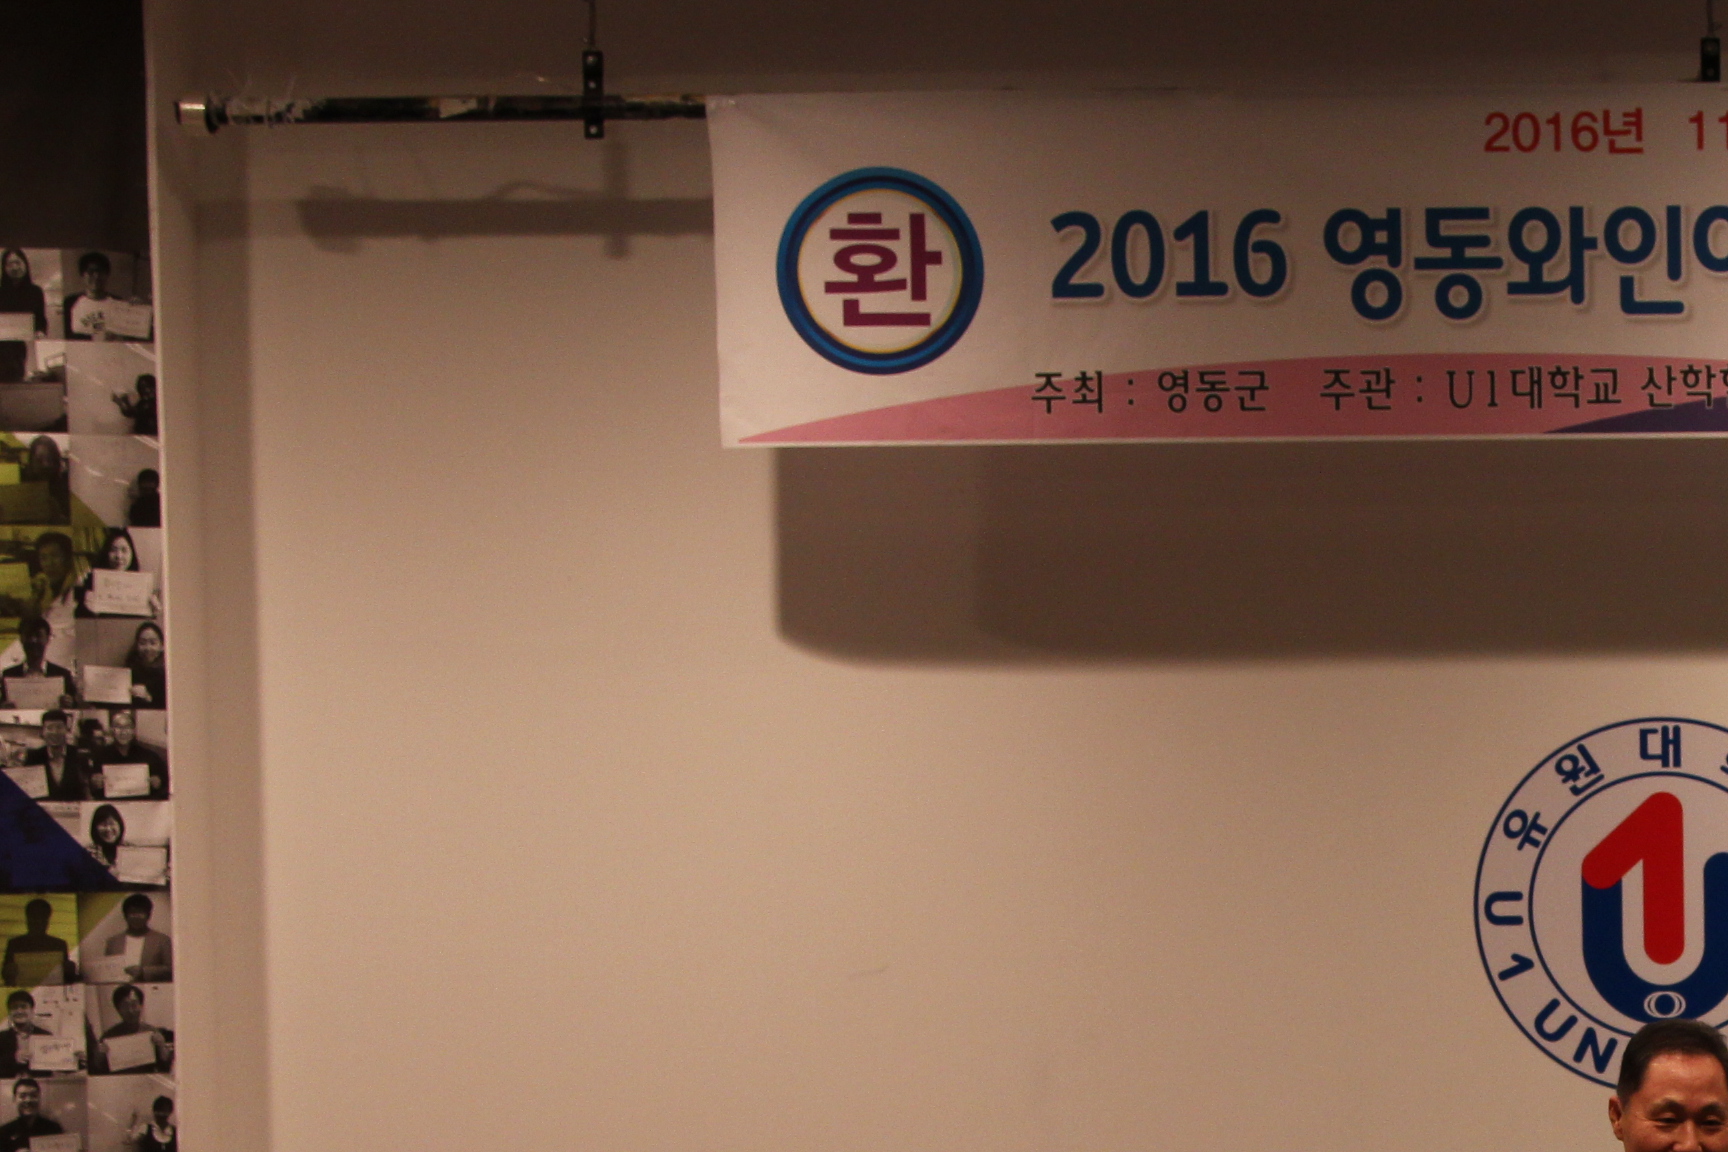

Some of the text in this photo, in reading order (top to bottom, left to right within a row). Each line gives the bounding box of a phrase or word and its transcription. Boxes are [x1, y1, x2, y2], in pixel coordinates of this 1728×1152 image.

[1484, 106, 1644, 154] 2016년
[824, 212, 943, 327] 환
[1050, 209, 1288, 299] 2016
[1031, 369, 1103, 414] 주최
[1158, 369, 1269, 413] 영동군
[1320, 367, 1395, 411] 주관
